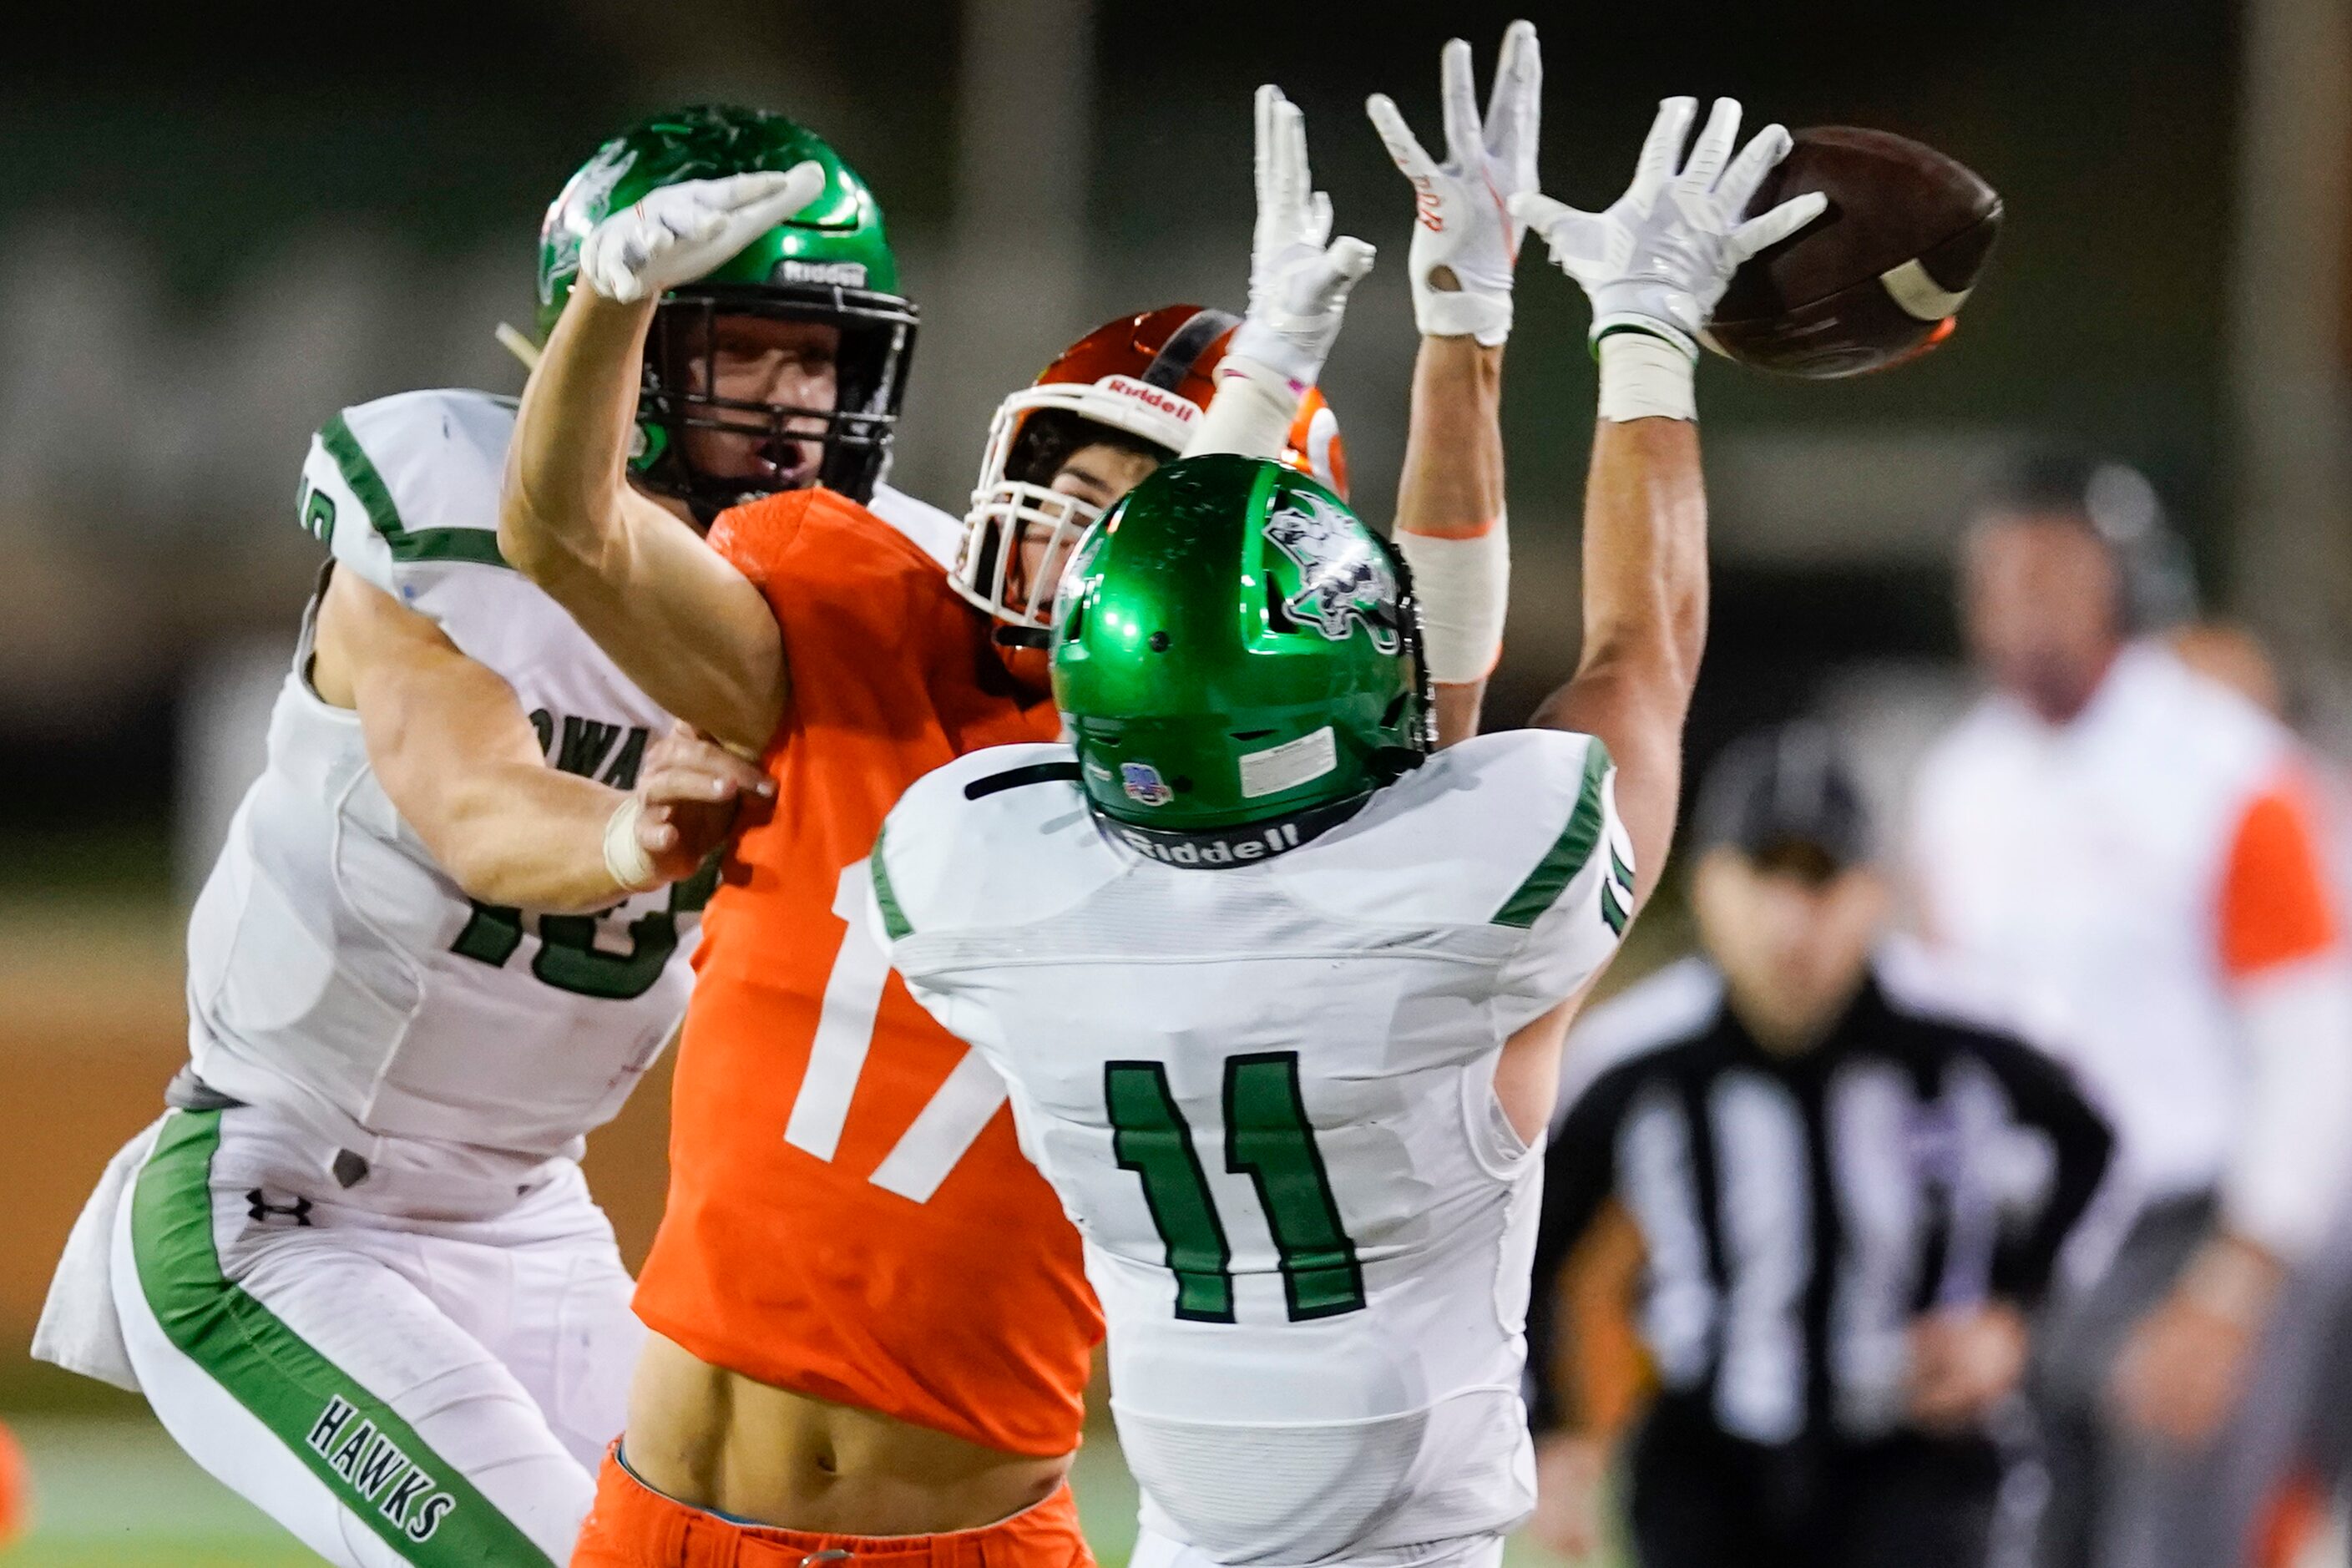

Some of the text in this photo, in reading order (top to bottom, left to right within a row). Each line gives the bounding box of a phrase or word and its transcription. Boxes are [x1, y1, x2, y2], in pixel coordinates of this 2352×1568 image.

[1108, 380, 1194, 422] Riddell
[1120, 822, 1300, 863] Riddell
[1104, 1050, 1367, 1324] 11
[306, 1393, 457, 1543] HAWKS
